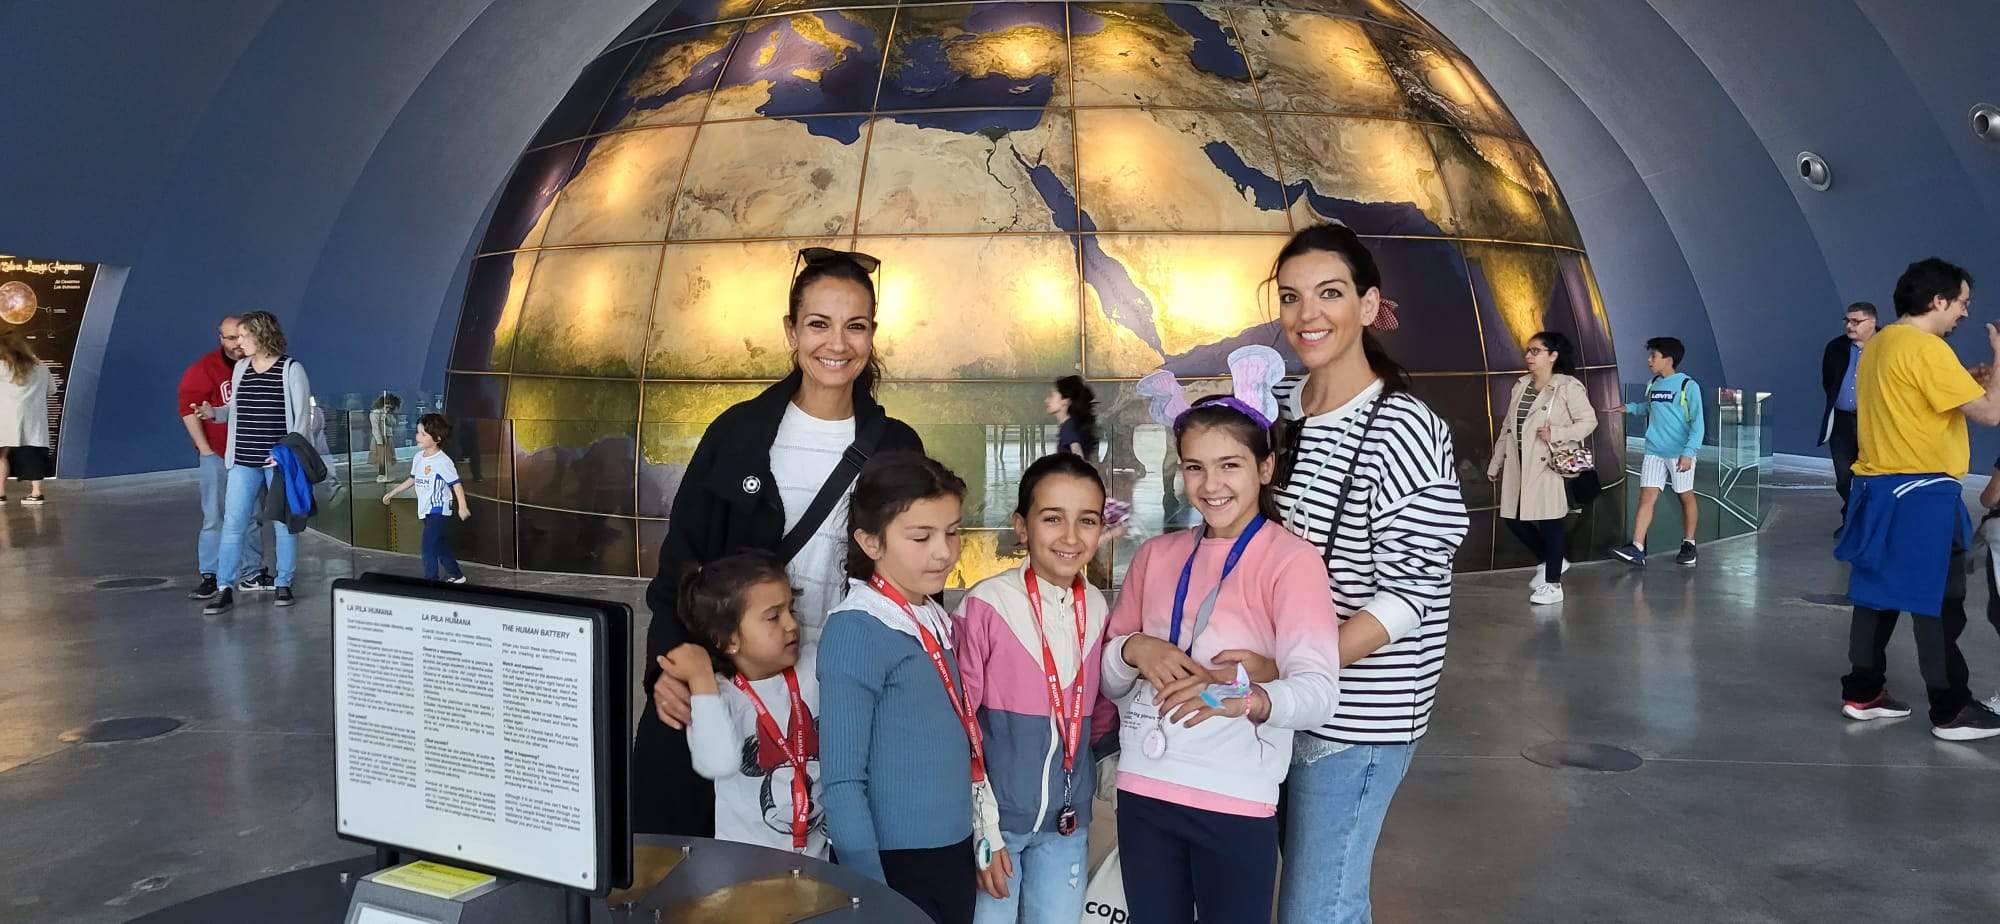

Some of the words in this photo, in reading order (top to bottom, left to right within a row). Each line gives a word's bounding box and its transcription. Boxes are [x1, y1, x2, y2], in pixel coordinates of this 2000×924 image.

[368, 607, 392, 616] HUMANA
[444, 616, 470, 626] HUMANA
[515, 626, 538, 635] HUMAN
[540, 628, 569, 639] BATTERY
[1086, 901, 1130, 924] cop
